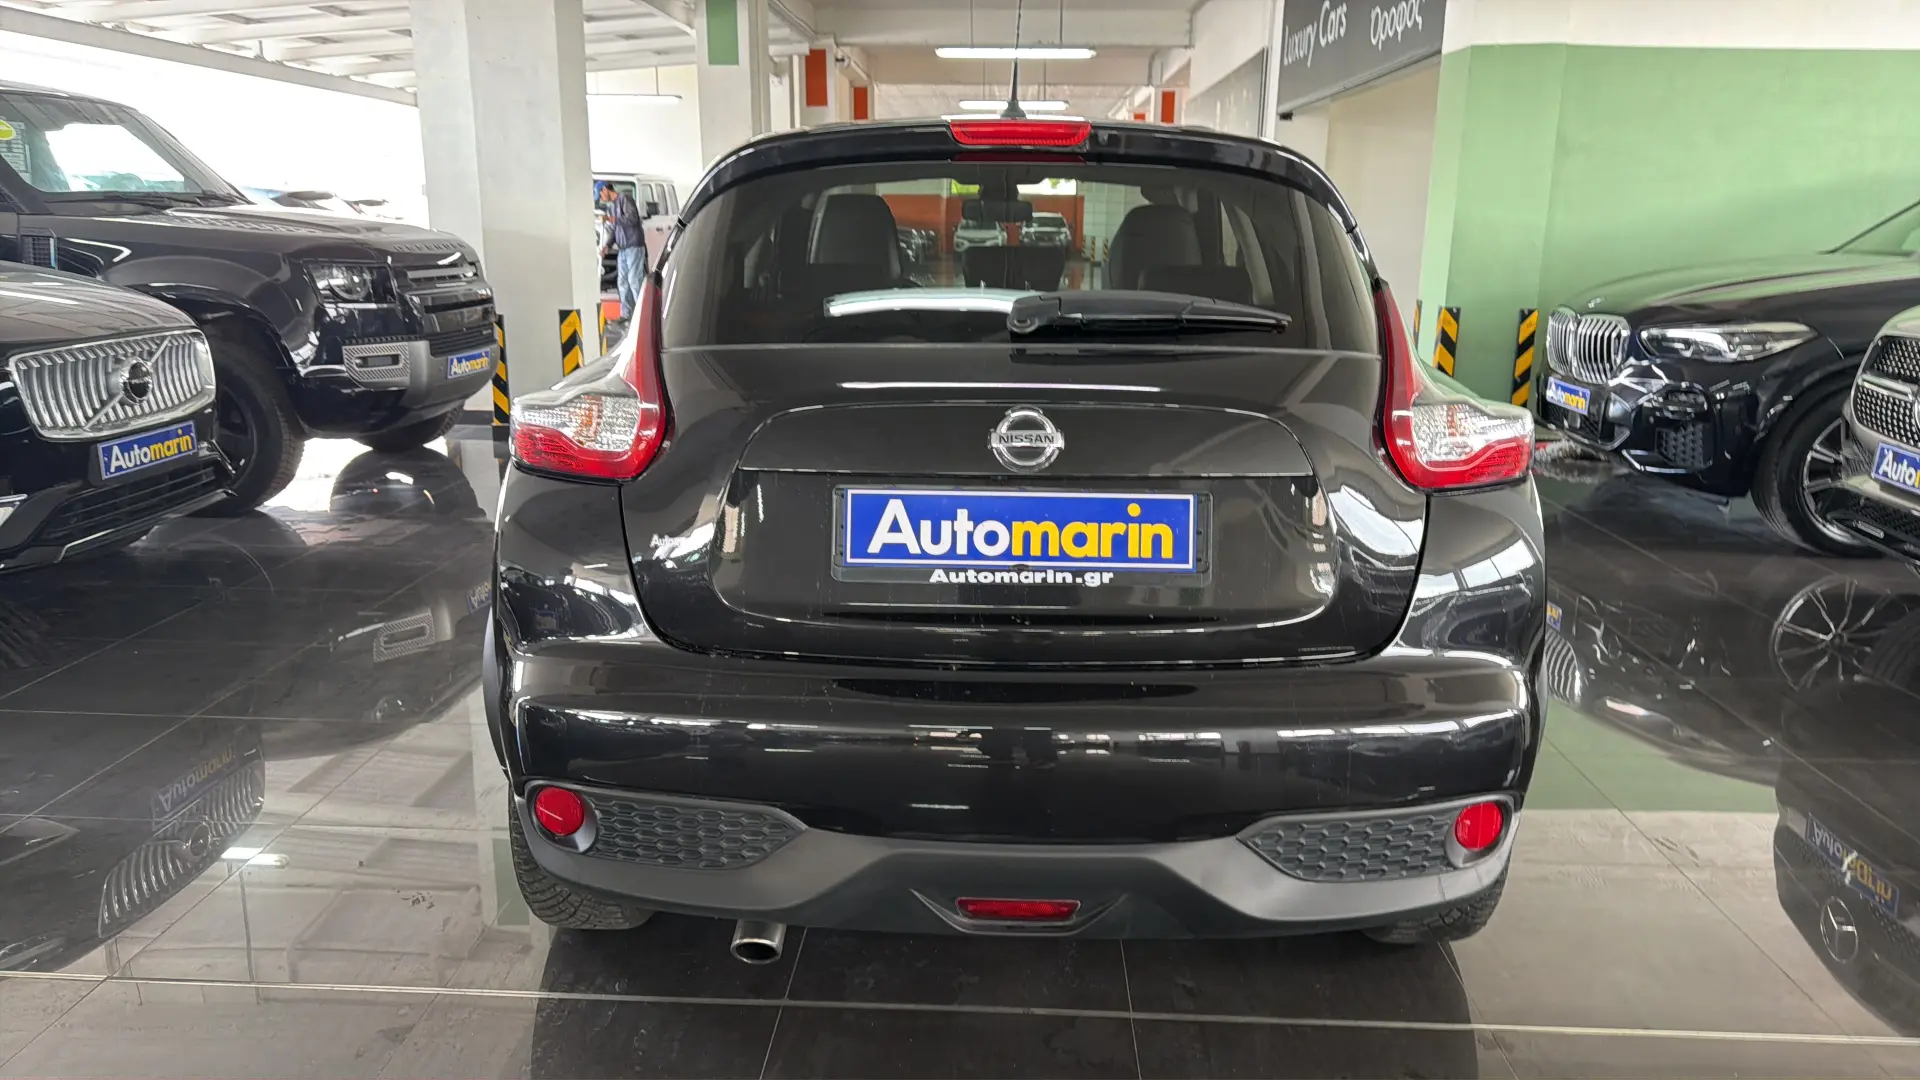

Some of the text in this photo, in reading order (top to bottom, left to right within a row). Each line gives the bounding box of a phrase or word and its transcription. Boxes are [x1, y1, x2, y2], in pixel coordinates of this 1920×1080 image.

[1284, 0, 1348, 68] Luxury Cars
[110, 429, 192, 472] Automarin
[999, 433, 1054, 443] NISSAN
[867, 498, 1173, 559] Automarin
[929, 568, 1114, 587] Automarin.gr
